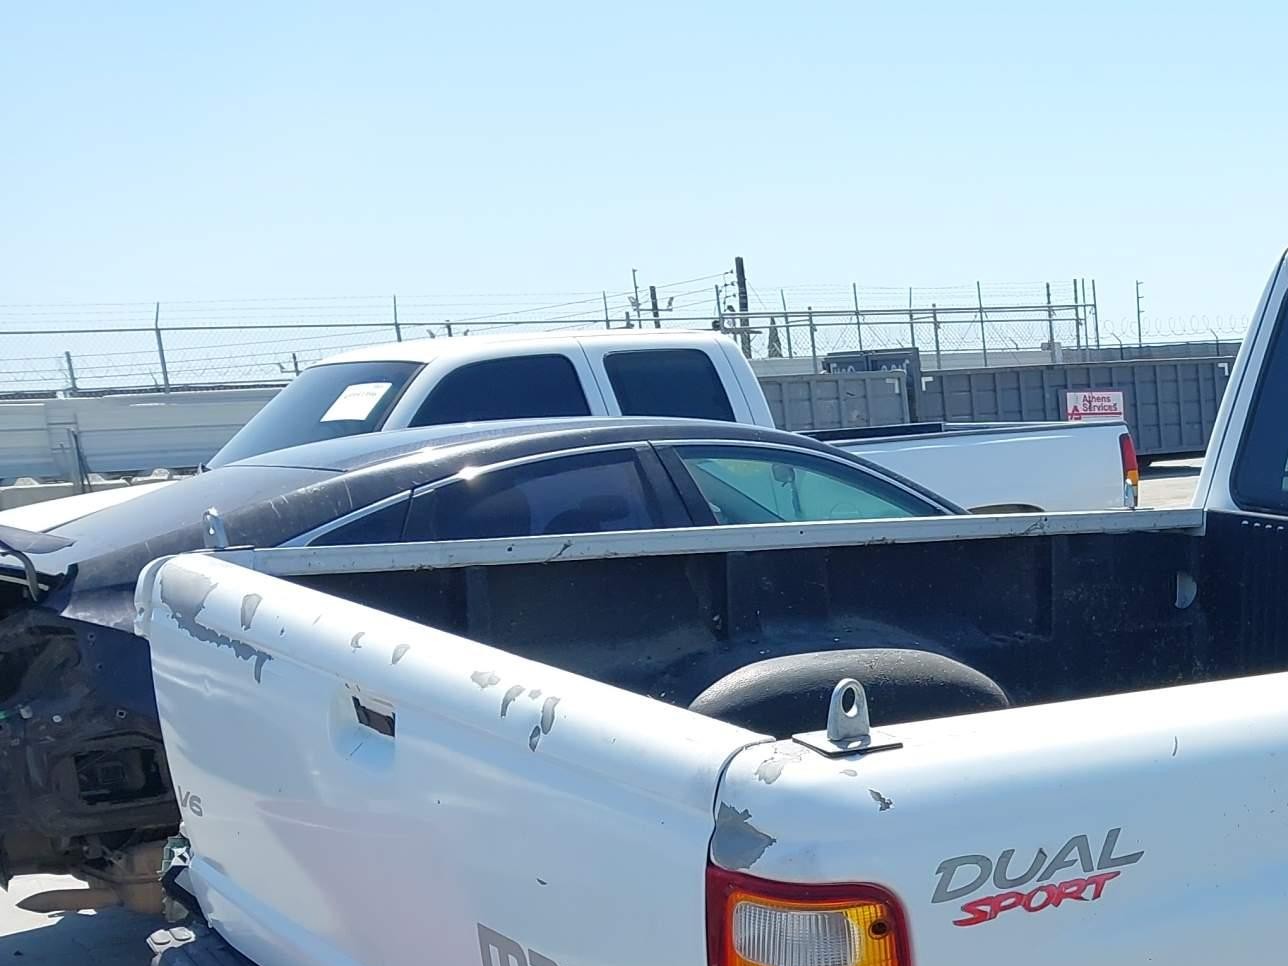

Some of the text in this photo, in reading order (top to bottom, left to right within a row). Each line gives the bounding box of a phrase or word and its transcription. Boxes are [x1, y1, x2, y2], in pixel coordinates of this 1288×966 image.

[1082, 394, 1112, 403] Athens
[1082, 402, 1118, 412] Services
[178, 785, 203, 817] V6
[931, 827, 1145, 903] DUAL
[952, 870, 1121, 927] SPORT
